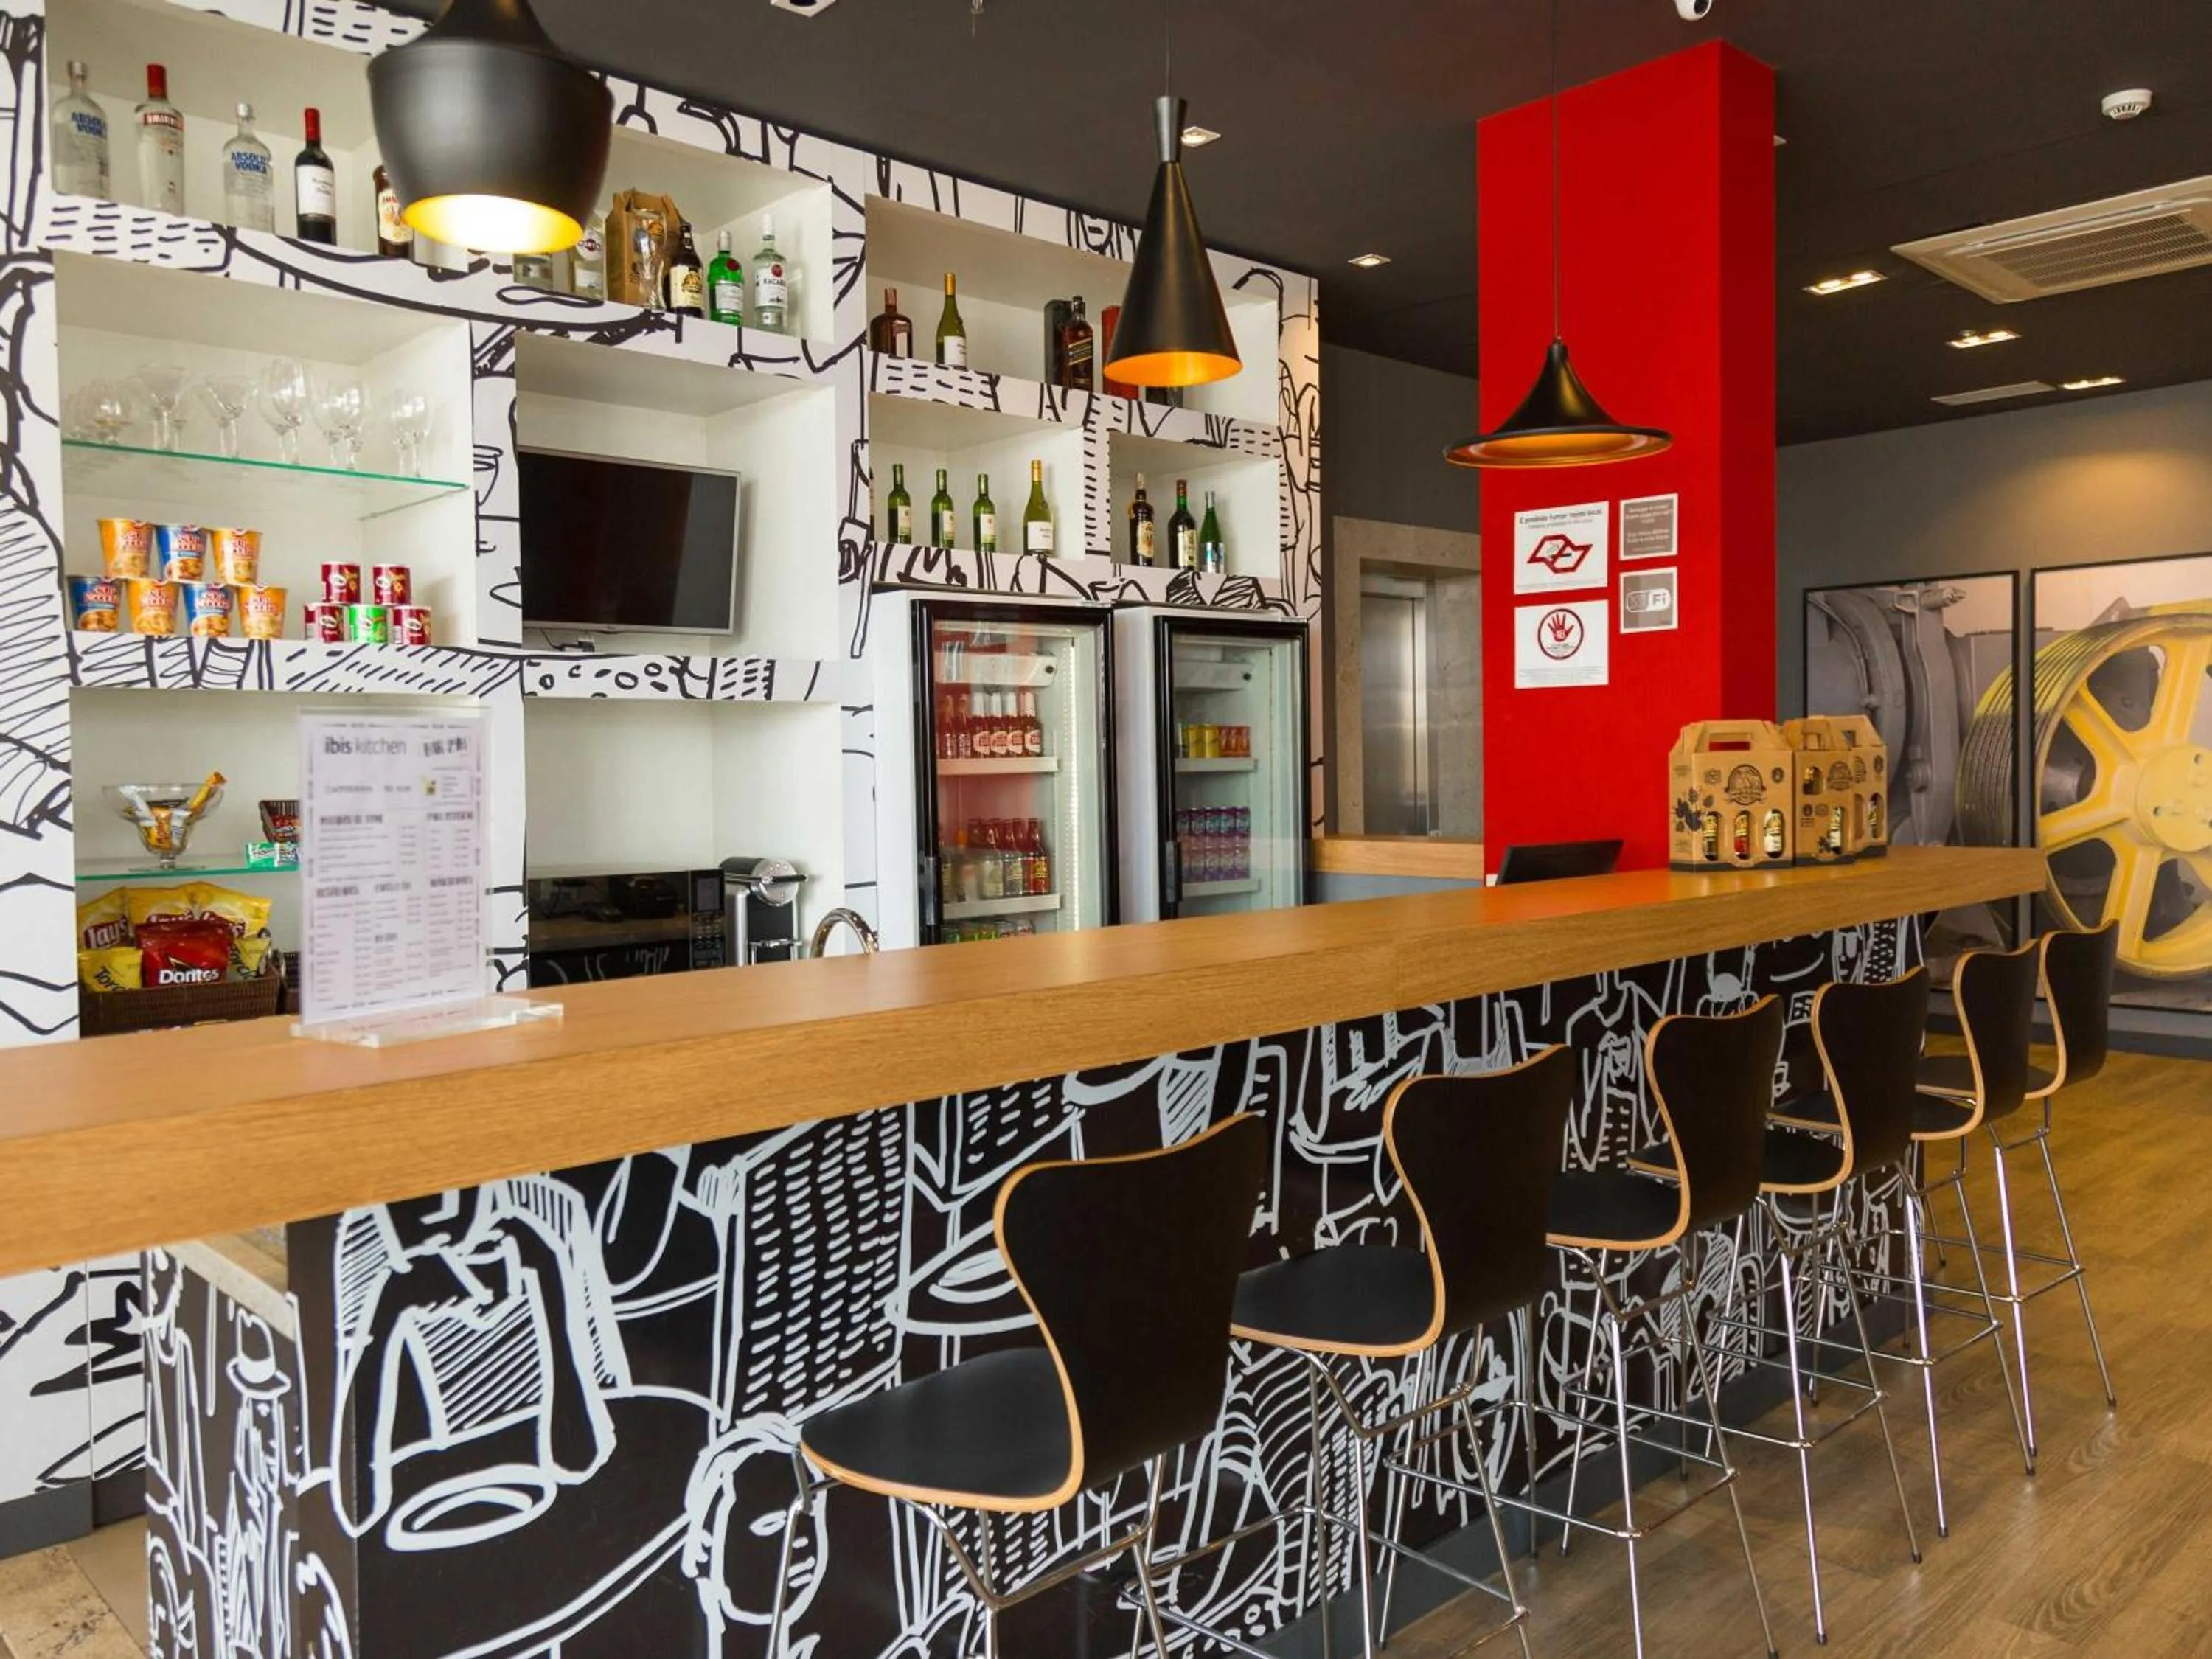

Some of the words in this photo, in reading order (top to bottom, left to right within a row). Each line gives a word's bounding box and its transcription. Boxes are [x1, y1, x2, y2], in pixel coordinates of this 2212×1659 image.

[1652, 593, 1666, 605] Fi
[325, 736, 352, 754] ibis
[355, 737, 406, 754] kitchen
[159, 968, 219, 984] Doritos
